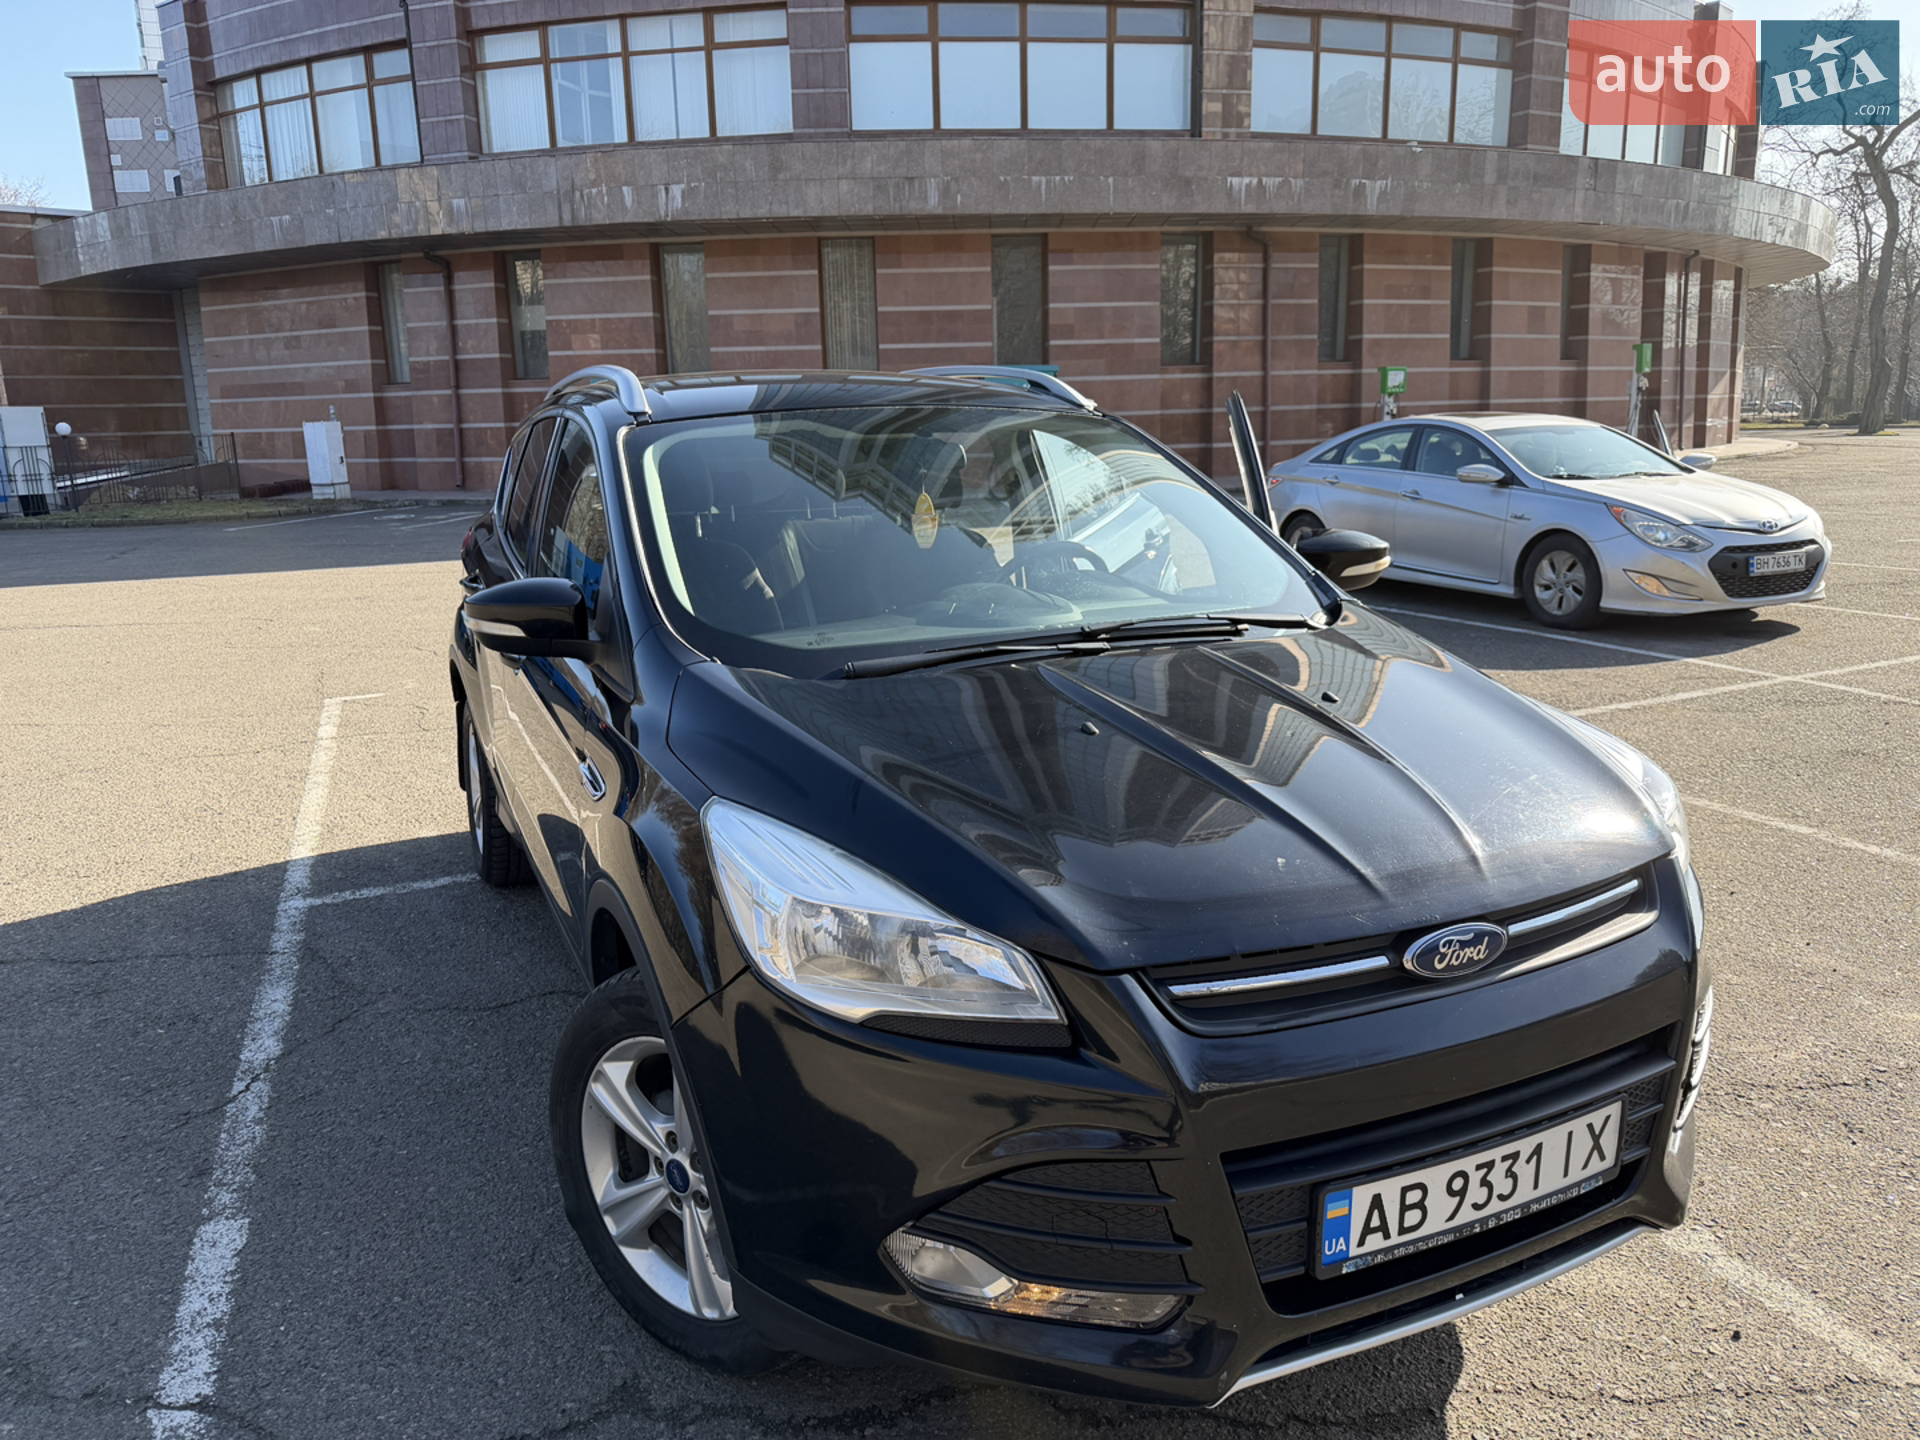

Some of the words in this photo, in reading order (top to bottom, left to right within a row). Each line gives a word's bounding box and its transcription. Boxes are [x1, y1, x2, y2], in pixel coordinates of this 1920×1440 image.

[1756, 557, 1770, 570] BH
[1771, 556, 1791, 569] 7636
[1792, 554, 1804, 566] TK
[1434, 932, 1489, 970] Ford
[1356, 1182, 1429, 1248] AB
[1444, 1141, 1544, 1223] 9331
[1562, 1114, 1612, 1179] IX
[1324, 1236, 1347, 1256] UA
